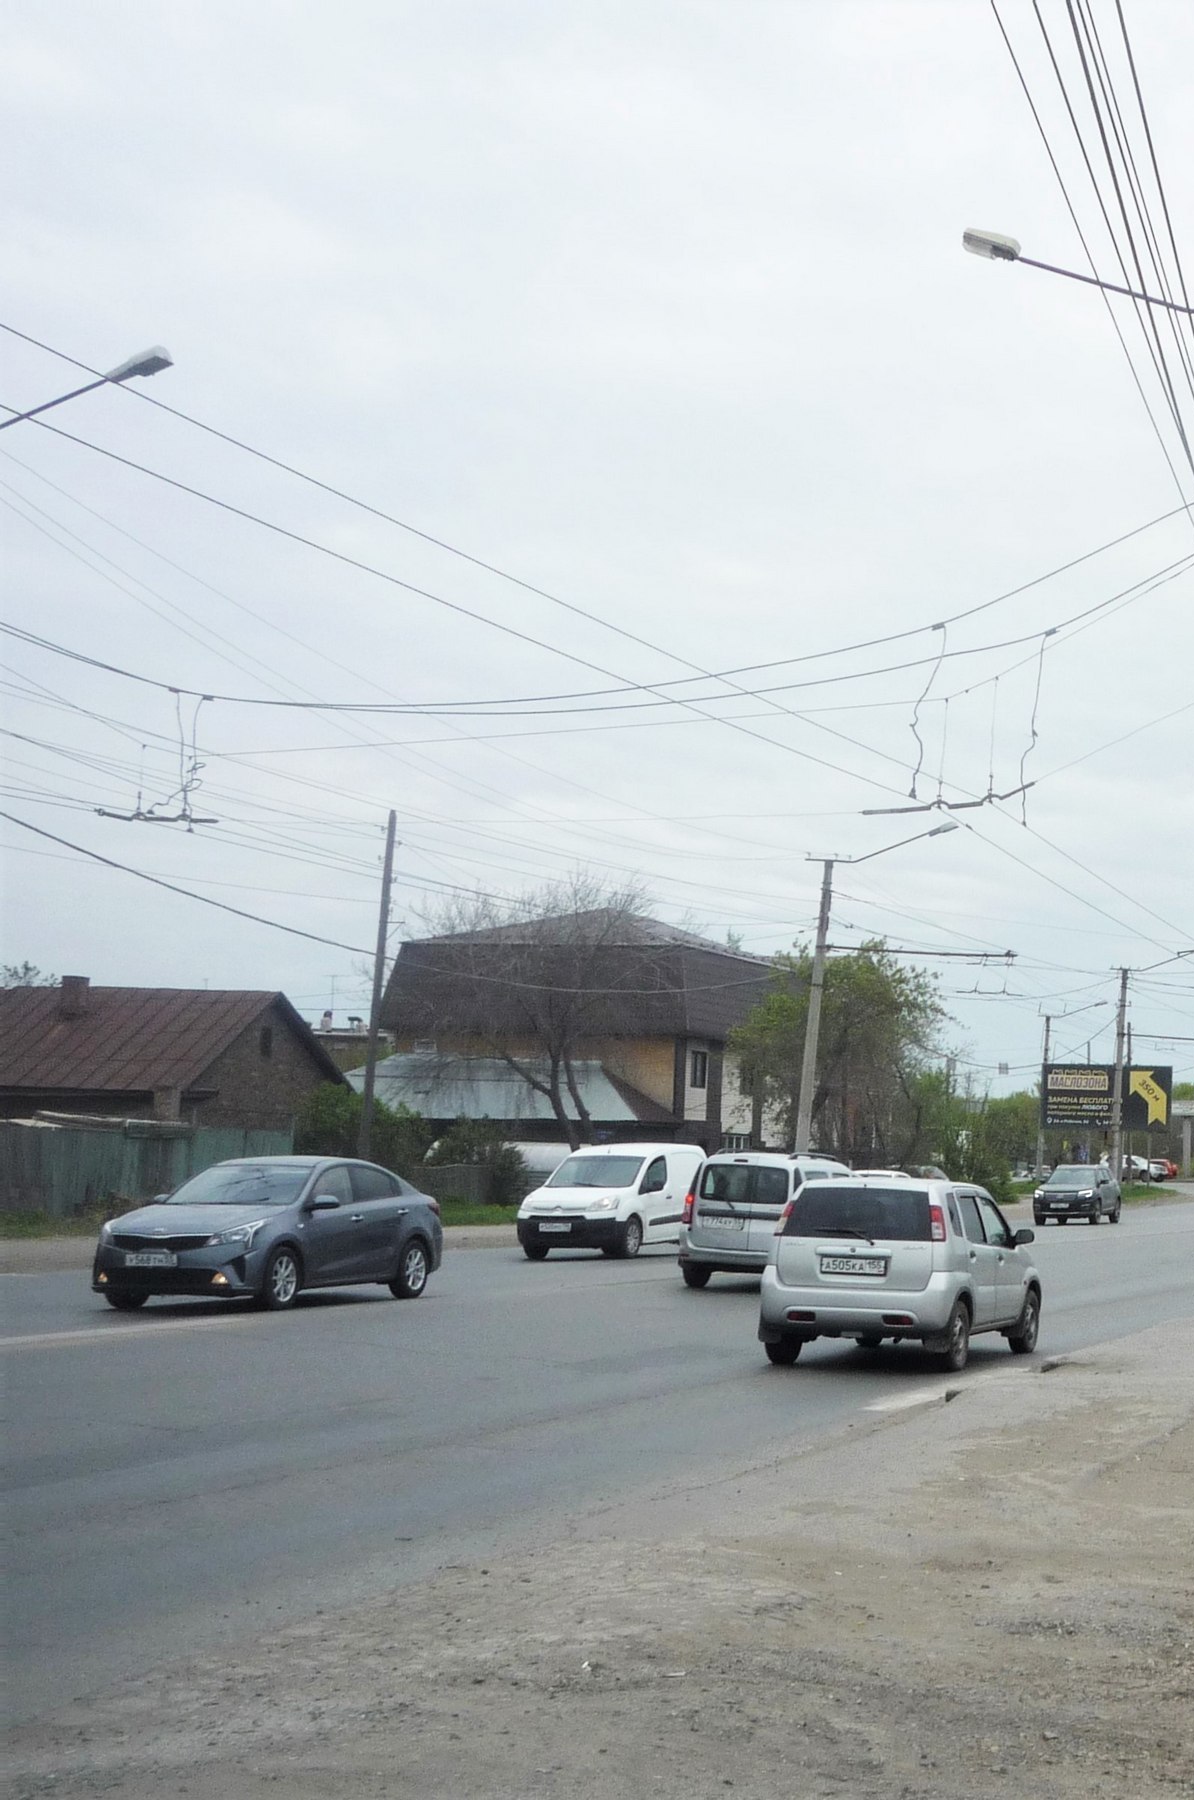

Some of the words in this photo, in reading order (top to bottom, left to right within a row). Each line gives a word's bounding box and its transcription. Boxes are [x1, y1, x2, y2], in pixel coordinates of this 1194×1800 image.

[1049, 1076, 1107, 1089] МАСЛОЗОНА
[1138, 1080, 1154, 1097] 350
[1047, 1096, 1078, 1104] ЗАМЕНА
